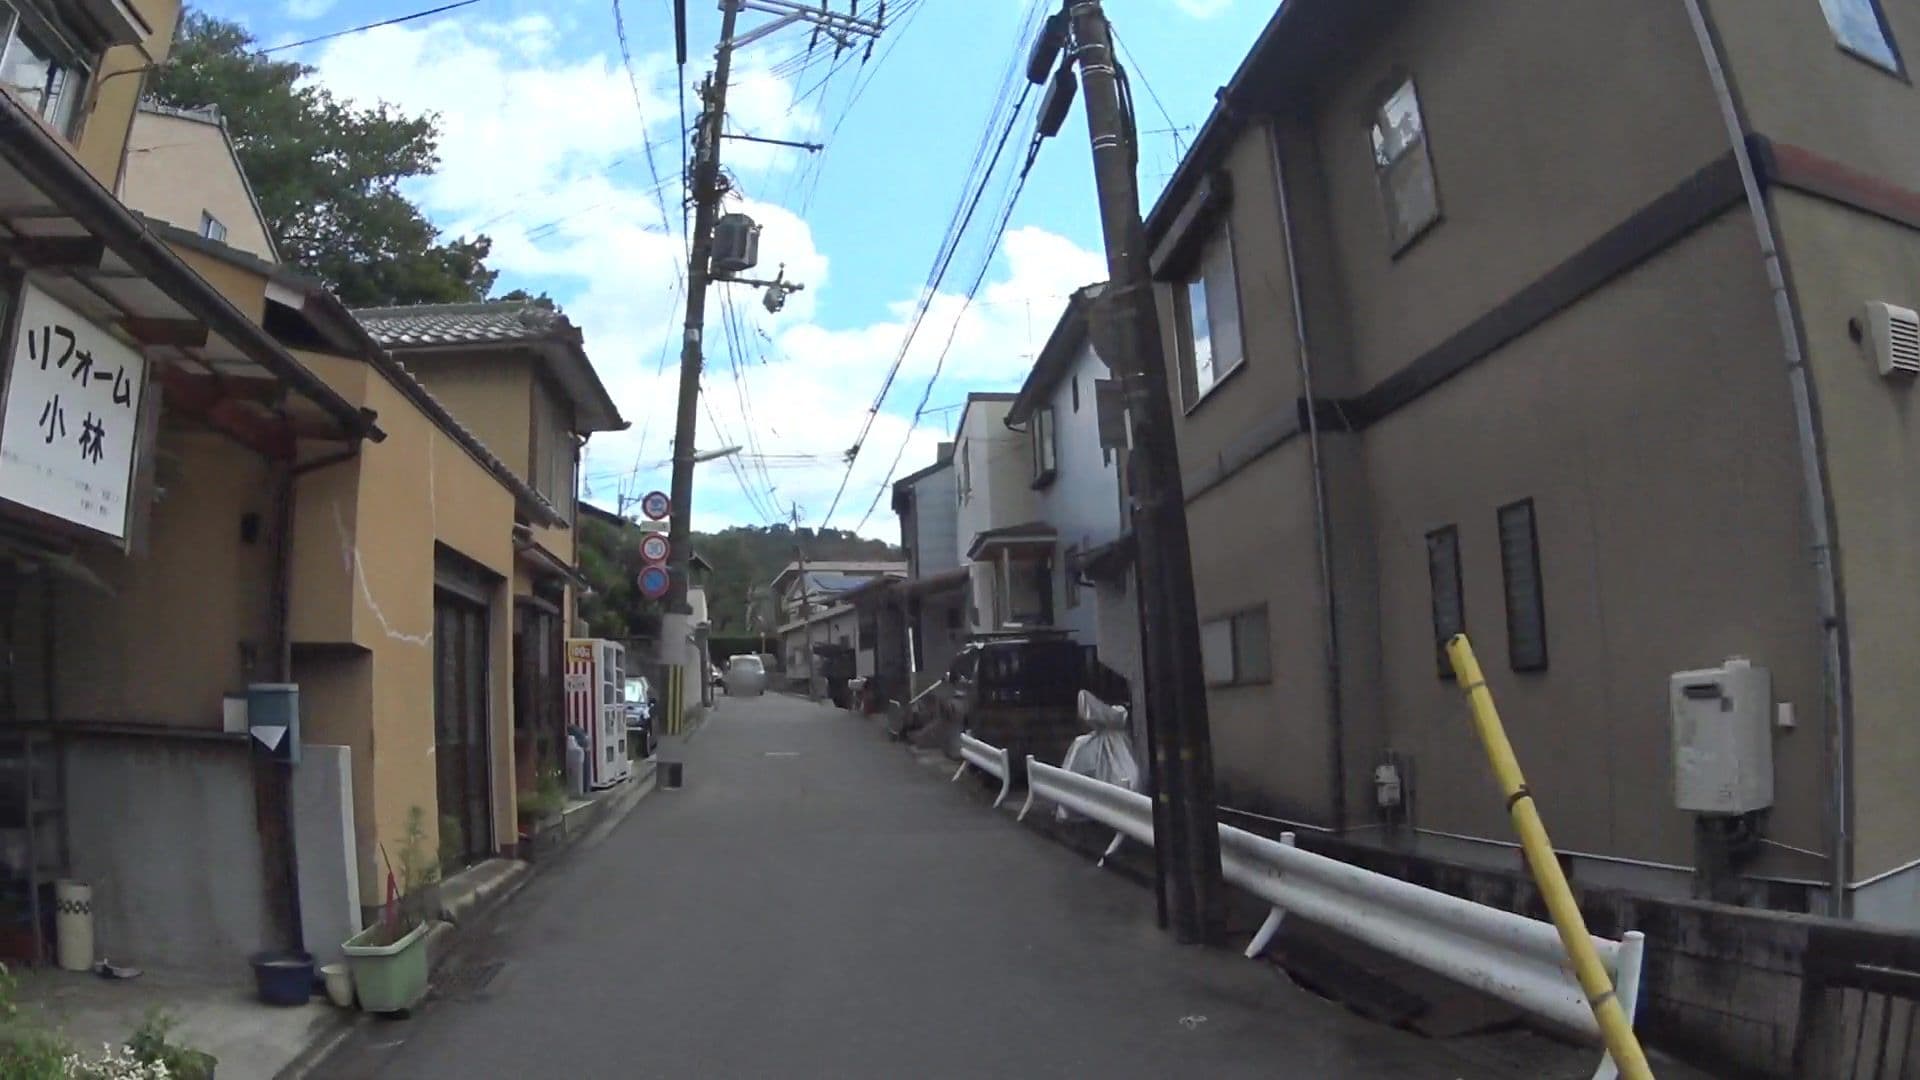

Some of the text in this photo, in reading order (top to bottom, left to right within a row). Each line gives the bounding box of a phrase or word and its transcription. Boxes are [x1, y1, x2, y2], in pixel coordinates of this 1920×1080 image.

[28, 324, 131, 409] リフォーム
[39, 393, 105, 465] 小林
